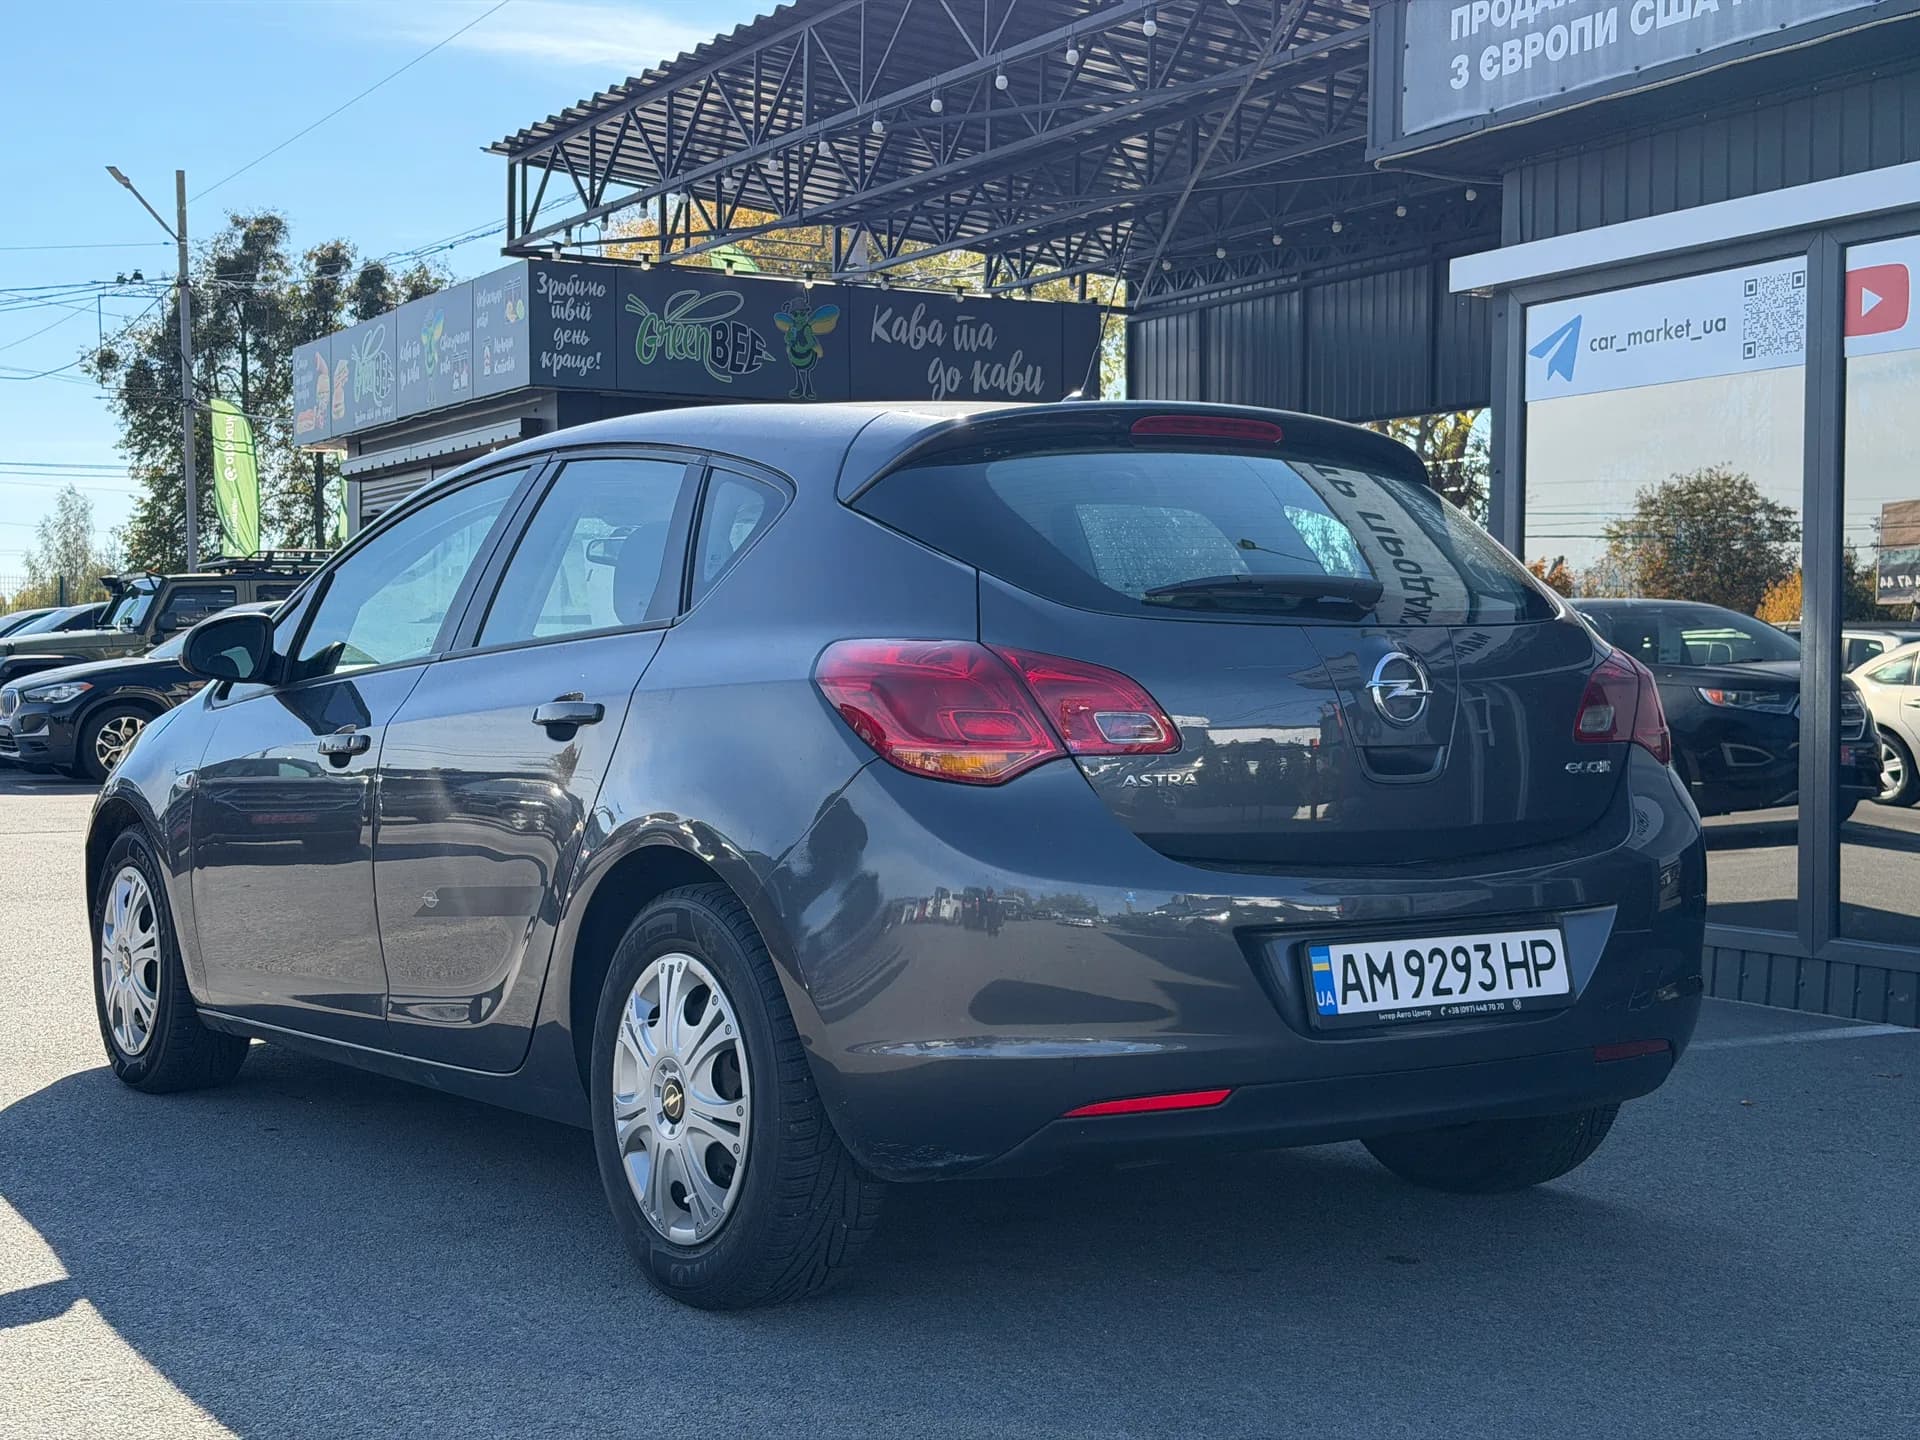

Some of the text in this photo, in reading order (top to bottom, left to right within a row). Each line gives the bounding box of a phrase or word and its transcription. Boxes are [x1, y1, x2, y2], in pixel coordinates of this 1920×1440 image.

[1450, 0, 1577, 41] ПРОД
[1448, 54, 1470, 90] З
[1479, 7, 1617, 81] ЄВРОПИ
[536, 271, 607, 302] Зробимо
[551, 300, 592, 322] твій
[553, 327, 590, 350] день
[871, 302, 997, 352] Кава та
[1589, 317, 1727, 352] car_market_ua
[540, 351, 602, 377] краще!
[928, 350, 1044, 401] до кави
[1121, 773, 1199, 788] ASTRA
[1317, 991, 1335, 1006] UA
